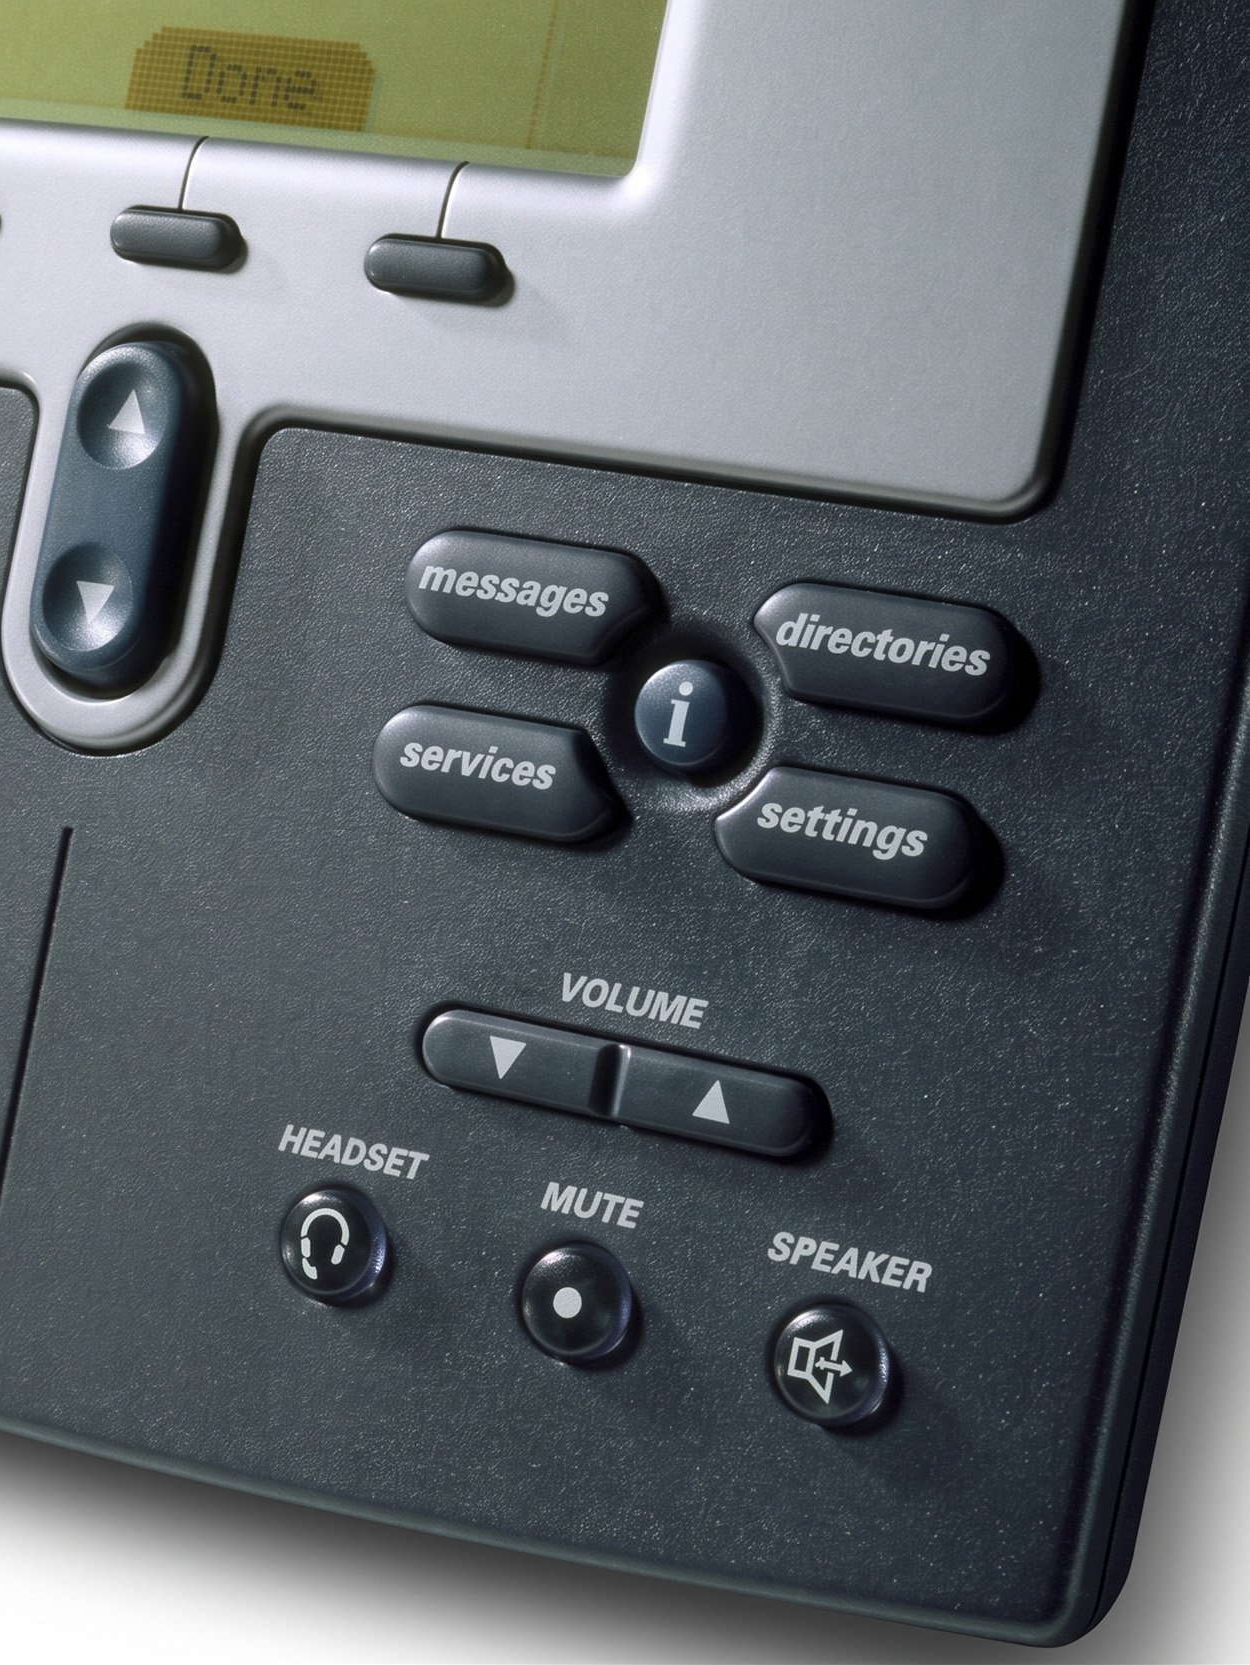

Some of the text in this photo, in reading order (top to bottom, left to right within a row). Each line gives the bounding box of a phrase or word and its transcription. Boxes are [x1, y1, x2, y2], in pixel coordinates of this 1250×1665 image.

[184, 44, 319, 111] Done
[419, 564, 609, 618] messages
[775, 612, 991, 677] directories
[662, 680, 693, 748] i
[399, 741, 556, 790] services
[756, 800, 928, 861] settings
[560, 972, 708, 1029] VOLUME
[278, 1124, 429, 1181] HEADSET
[540, 1182, 644, 1230] MUTE
[766, 1232, 933, 1293] SPEAKER
